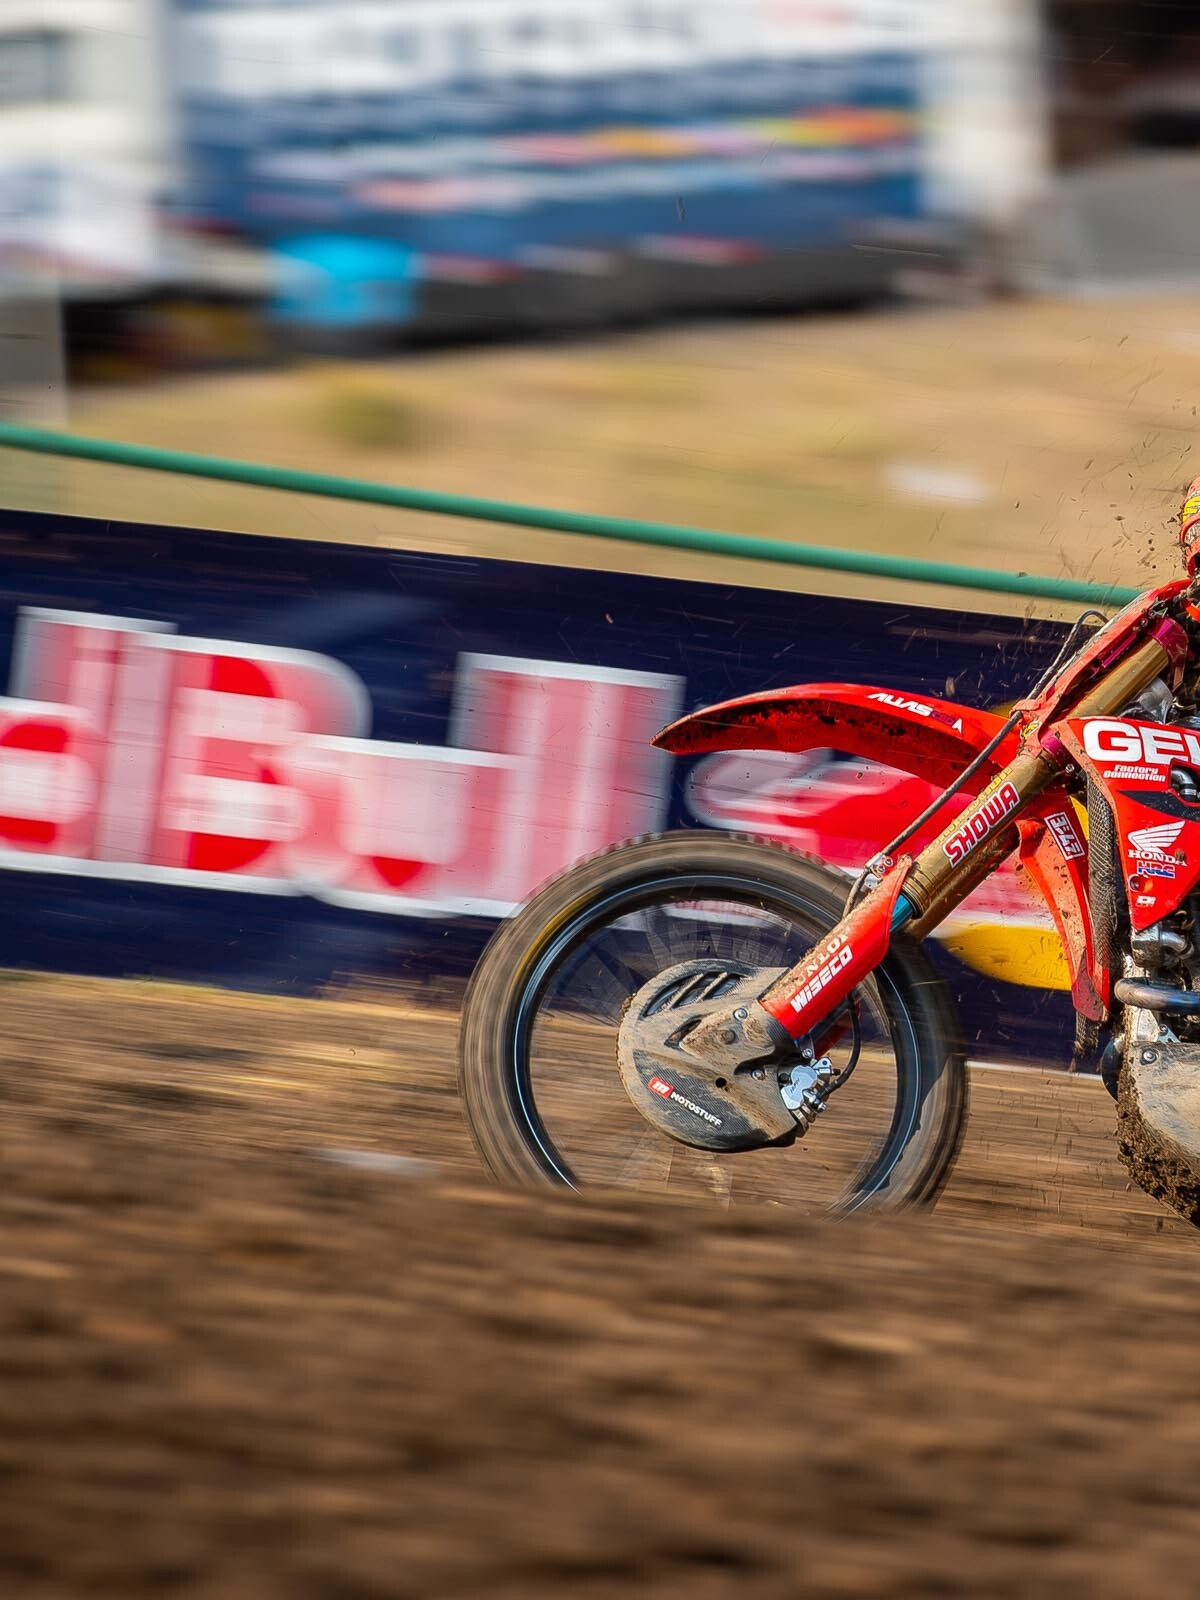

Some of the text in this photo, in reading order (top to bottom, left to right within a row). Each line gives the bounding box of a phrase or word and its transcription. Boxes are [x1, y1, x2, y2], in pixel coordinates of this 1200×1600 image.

[1103, 770, 1166, 782] Connection
[1114, 764, 1159, 775] Factory
[943, 782, 1040, 868] SHOWA
[1136, 860, 1176, 878] HRC
